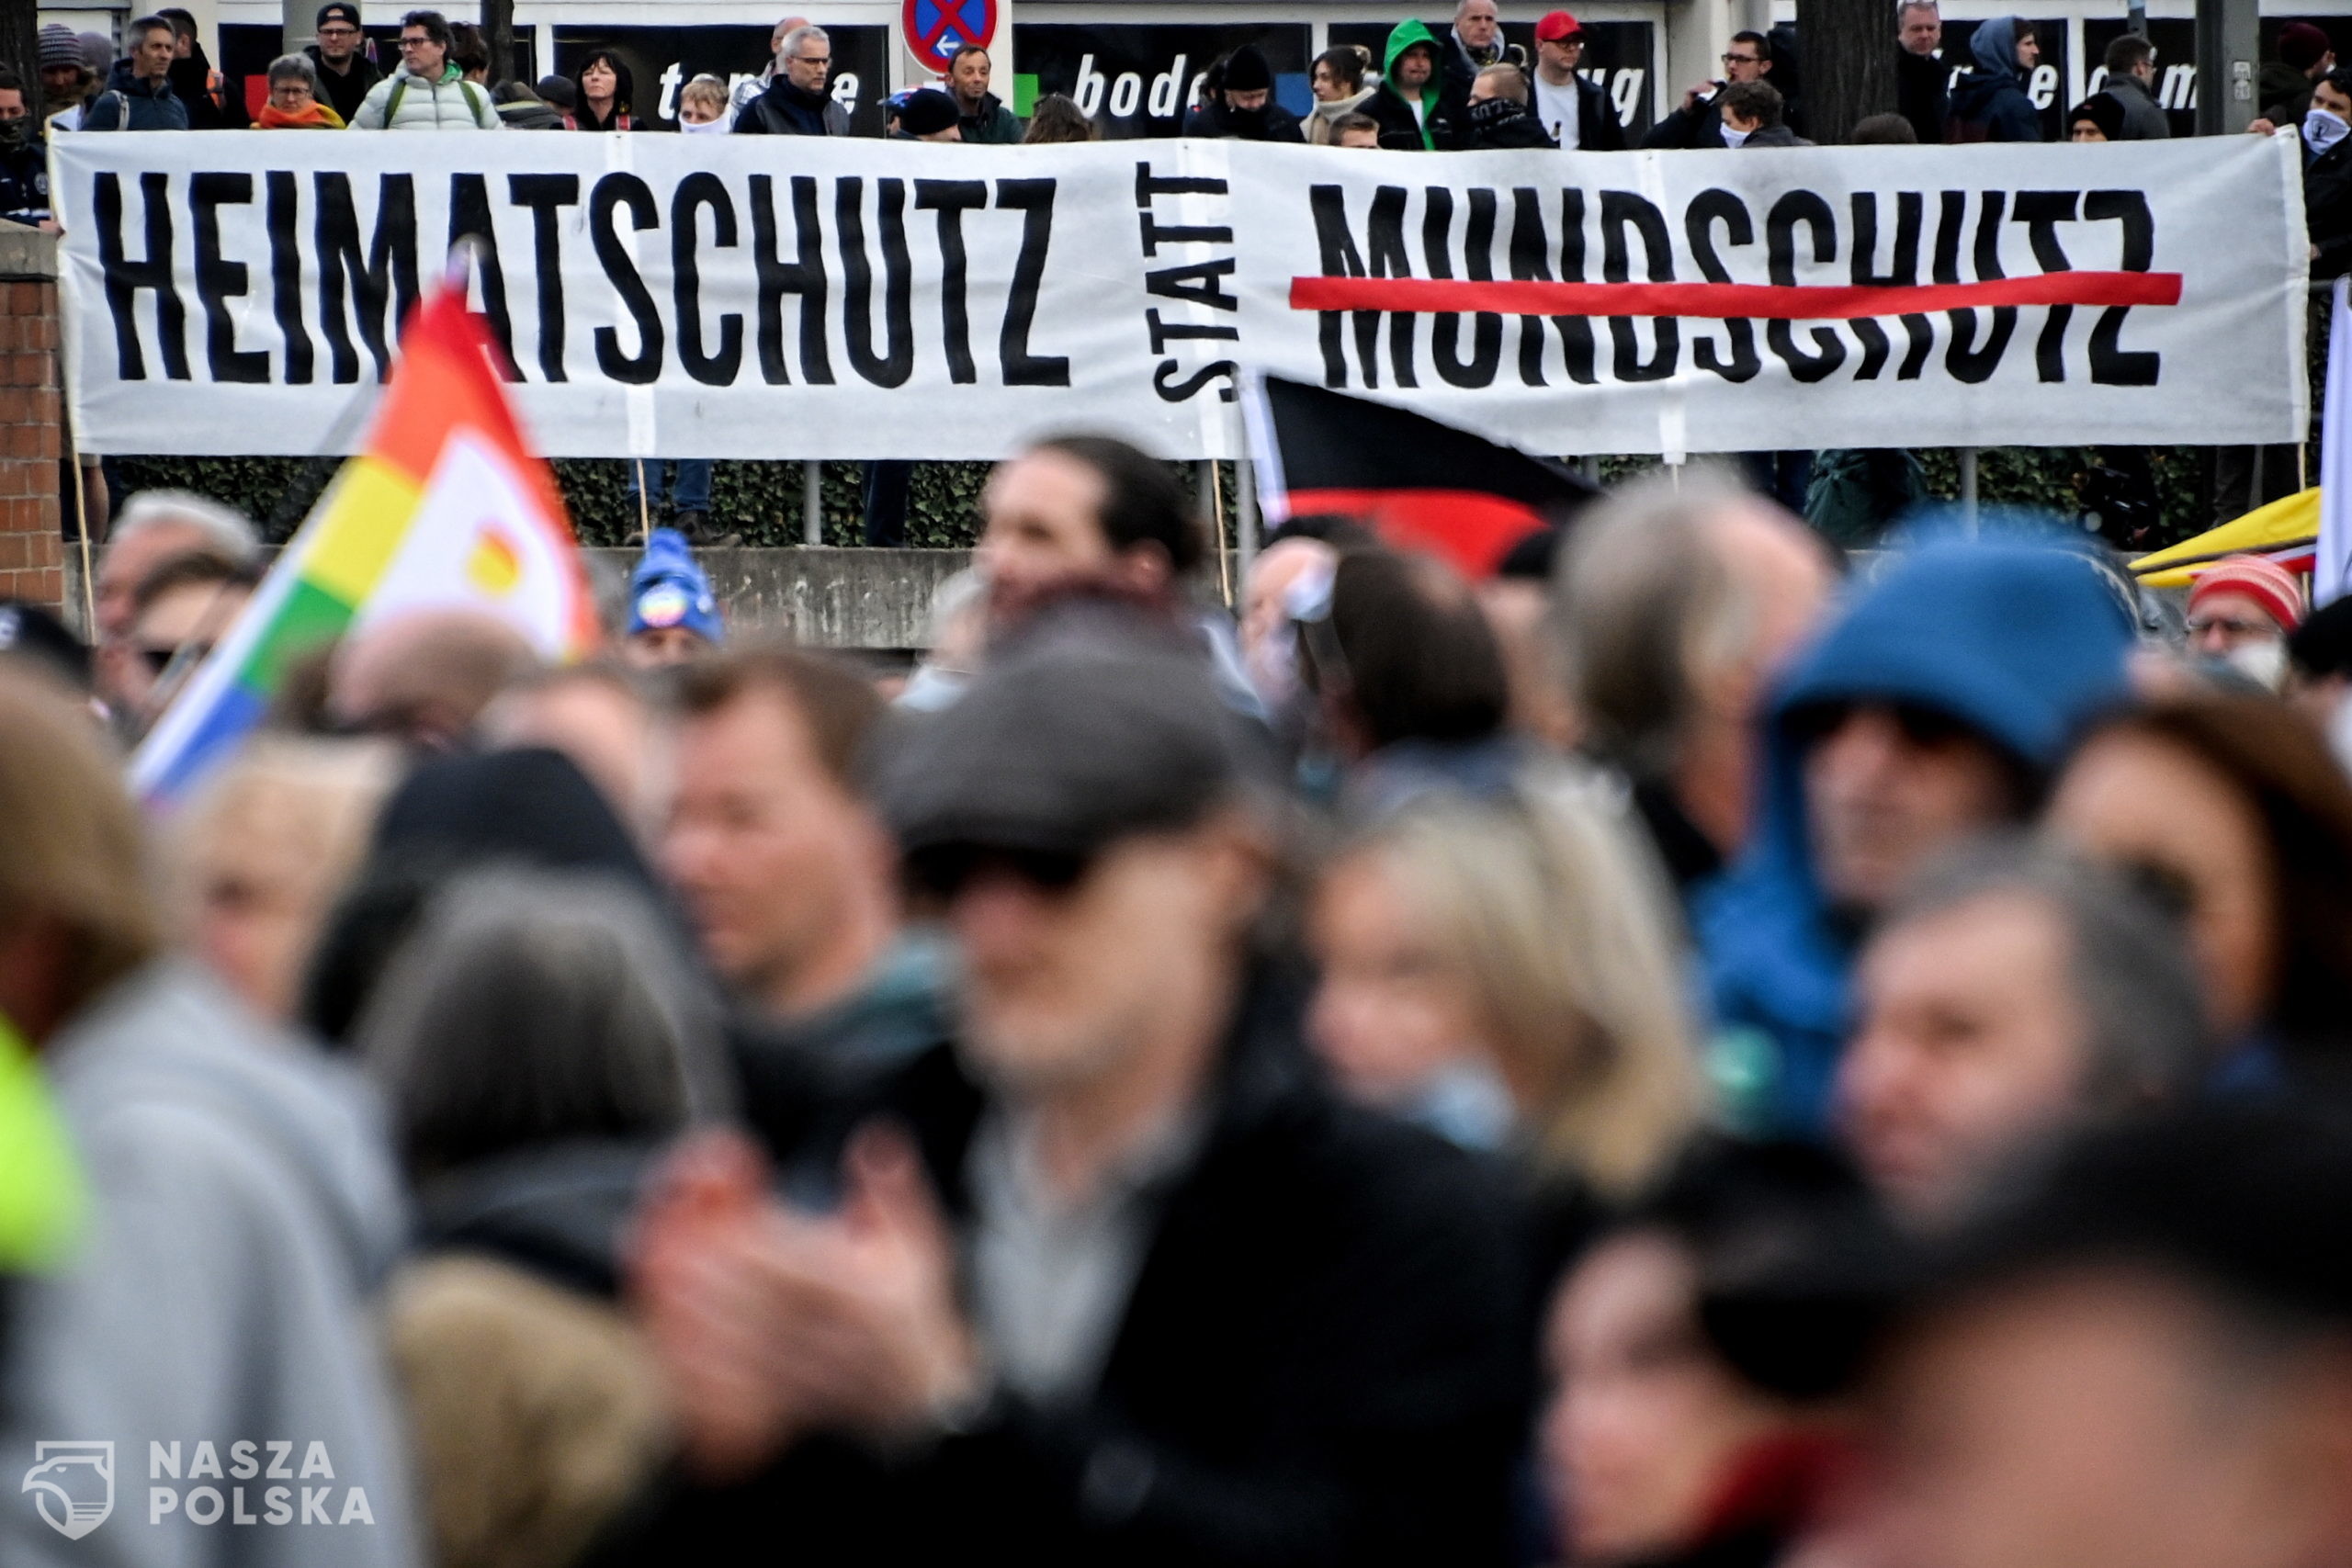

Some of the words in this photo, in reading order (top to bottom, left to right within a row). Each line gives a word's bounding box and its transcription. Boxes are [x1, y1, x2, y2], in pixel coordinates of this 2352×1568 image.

[94, 171, 1069, 388] HEIMATSCHUTZ
[1136, 162, 1239, 402] STATT
[1310, 185, 2160, 389] MUNDSCHUTZ
